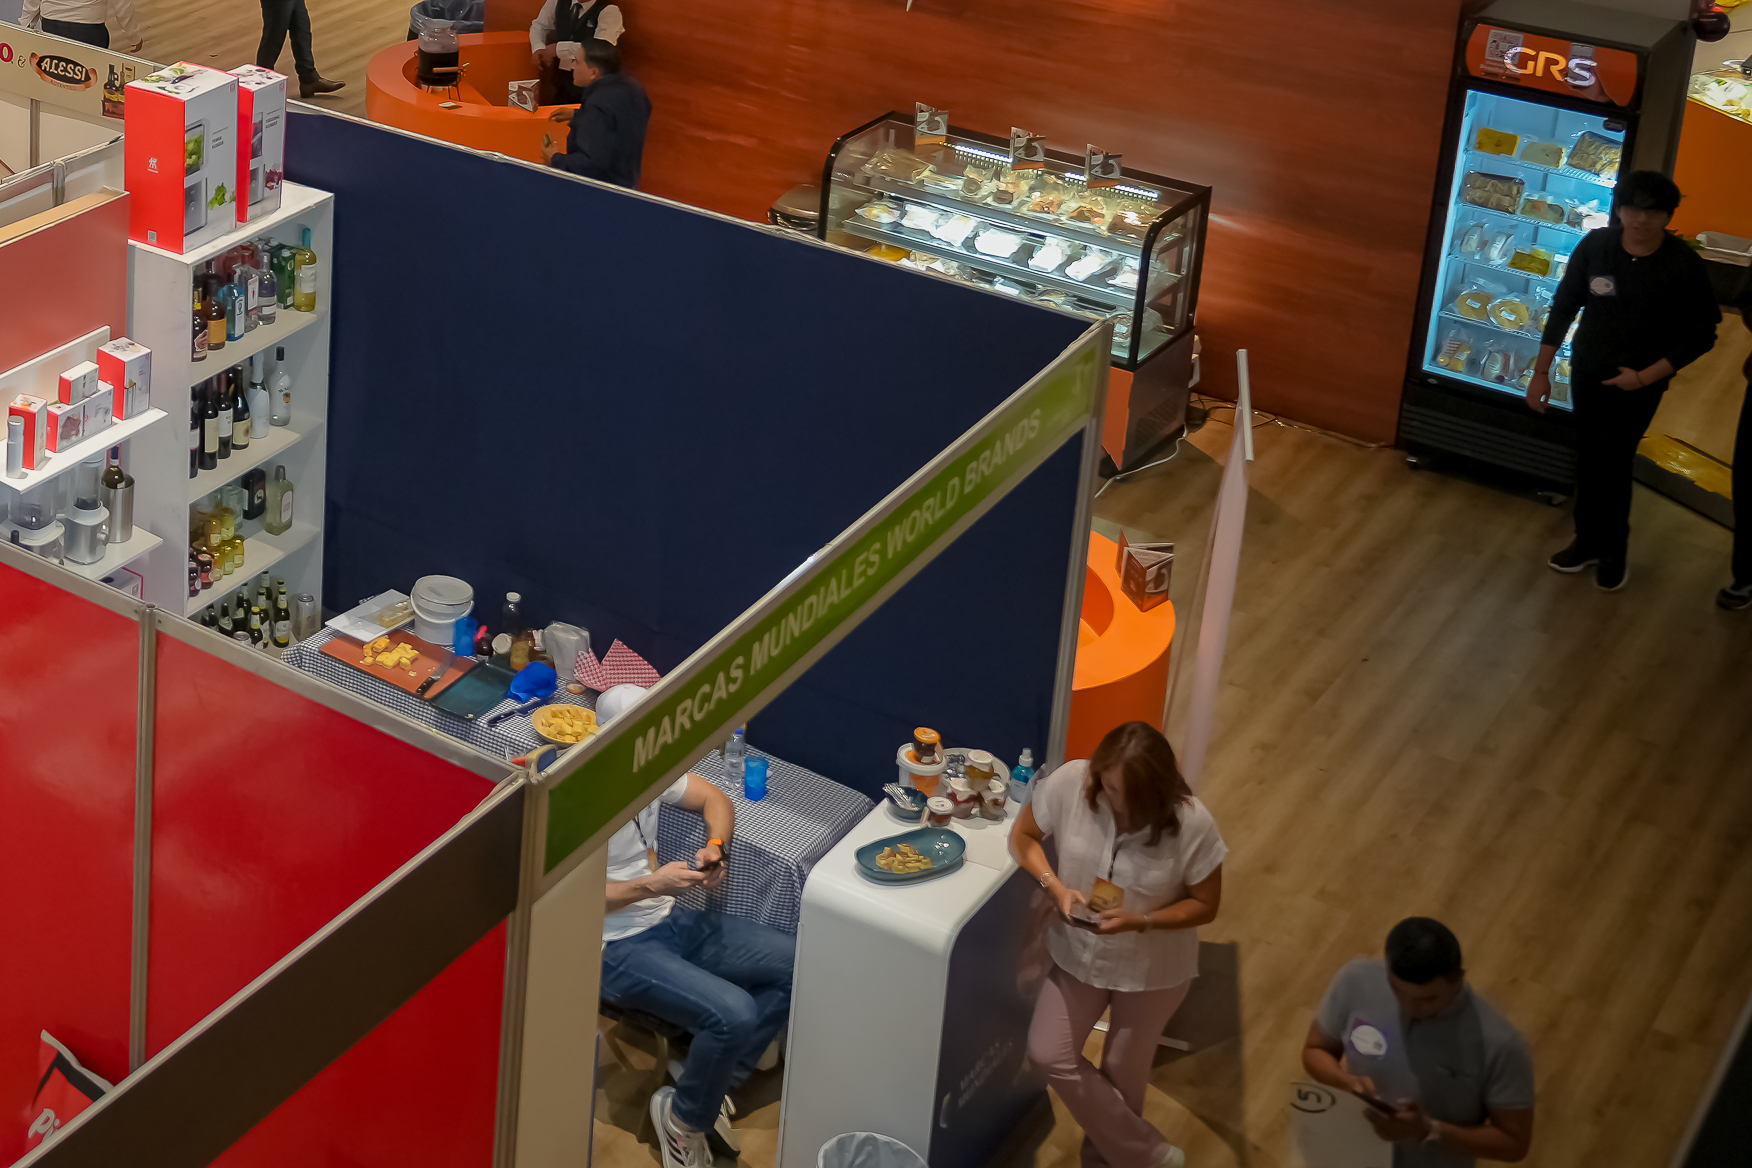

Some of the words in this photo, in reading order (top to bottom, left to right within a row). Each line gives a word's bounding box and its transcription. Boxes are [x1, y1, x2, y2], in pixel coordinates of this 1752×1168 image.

[40, 57, 87, 81] ALESSI
[1503, 46, 1598, 87] GRS
[631, 655, 745, 773] MARCAS
[750, 542, 881, 677] MUNDIALES
[886, 476, 961, 561] WORLD
[962, 408, 1041, 496] BRANDS
